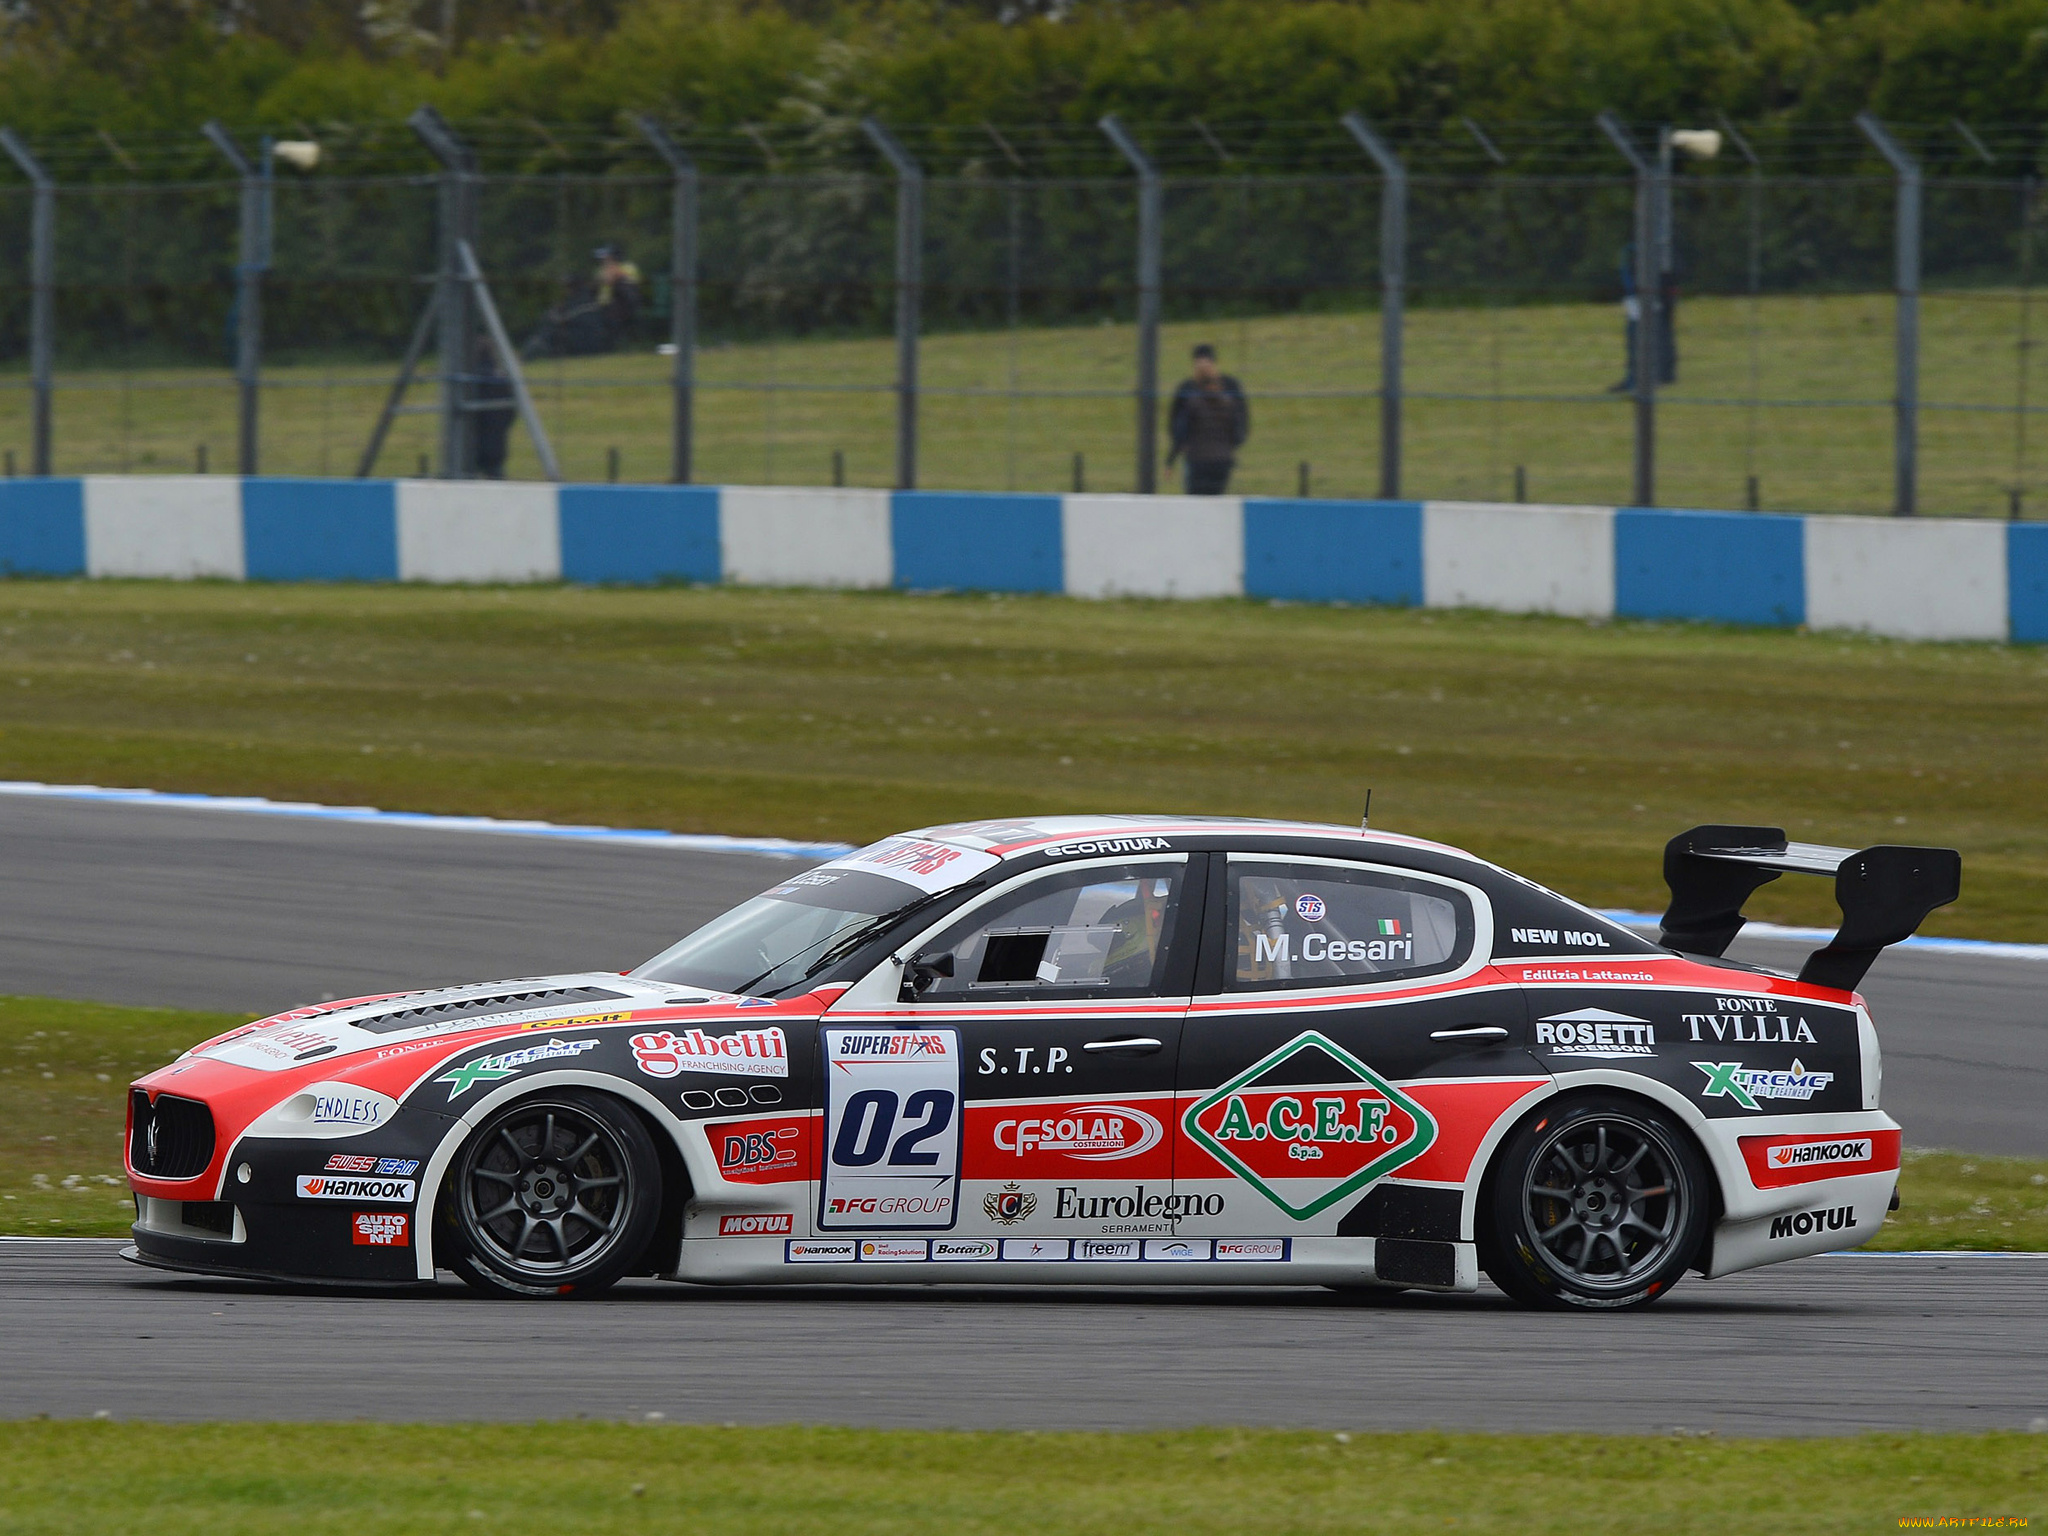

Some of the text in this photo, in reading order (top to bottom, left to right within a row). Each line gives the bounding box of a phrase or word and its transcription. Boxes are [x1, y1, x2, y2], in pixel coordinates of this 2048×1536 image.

[1298, 902, 1322, 912] STS
[1512, 928, 1610, 947] NEW MOL
[1522, 969, 1654, 982] Edilizia Lattanzio
[1716, 997, 1778, 1013] FONTE
[1537, 1023, 1656, 1045] ROSETTI
[377, 1040, 444, 1059] FONTE
[632, 1030, 786, 1075] gabetti
[841, 1033, 946, 1057] SUPERSTARS
[1552, 1045, 1653, 1054] ASCENSORI
[439, 1040, 598, 1096] XTREME
[681, 1060, 786, 1074] FRANCHISING AGENCY
[978, 1047, 1074, 1075] S.T.P.
[1696, 1063, 1827, 1107] XTREME
[315, 1097, 380, 1122] ENDLESS
[831, 1089, 956, 1167] 02
[723, 1131, 776, 1167] DBS
[325, 1154, 419, 1175] SWISS TEAM
[846, 1198, 950, 1213] FG GROUP
[1053, 1185, 1224, 1224] Eurolegno
[356, 1215, 405, 1226] AUTO
[358, 1225, 402, 1235] SPRI
[724, 1217, 789, 1232] MOTUL
[1770, 1206, 1857, 1239] MOTUL
[370, 1234, 394, 1244] NT
[936, 1245, 984, 1255] Bottari
[1170, 1249, 1193, 1257] WIGE
[1244, 1245, 1281, 1254] GROUP
